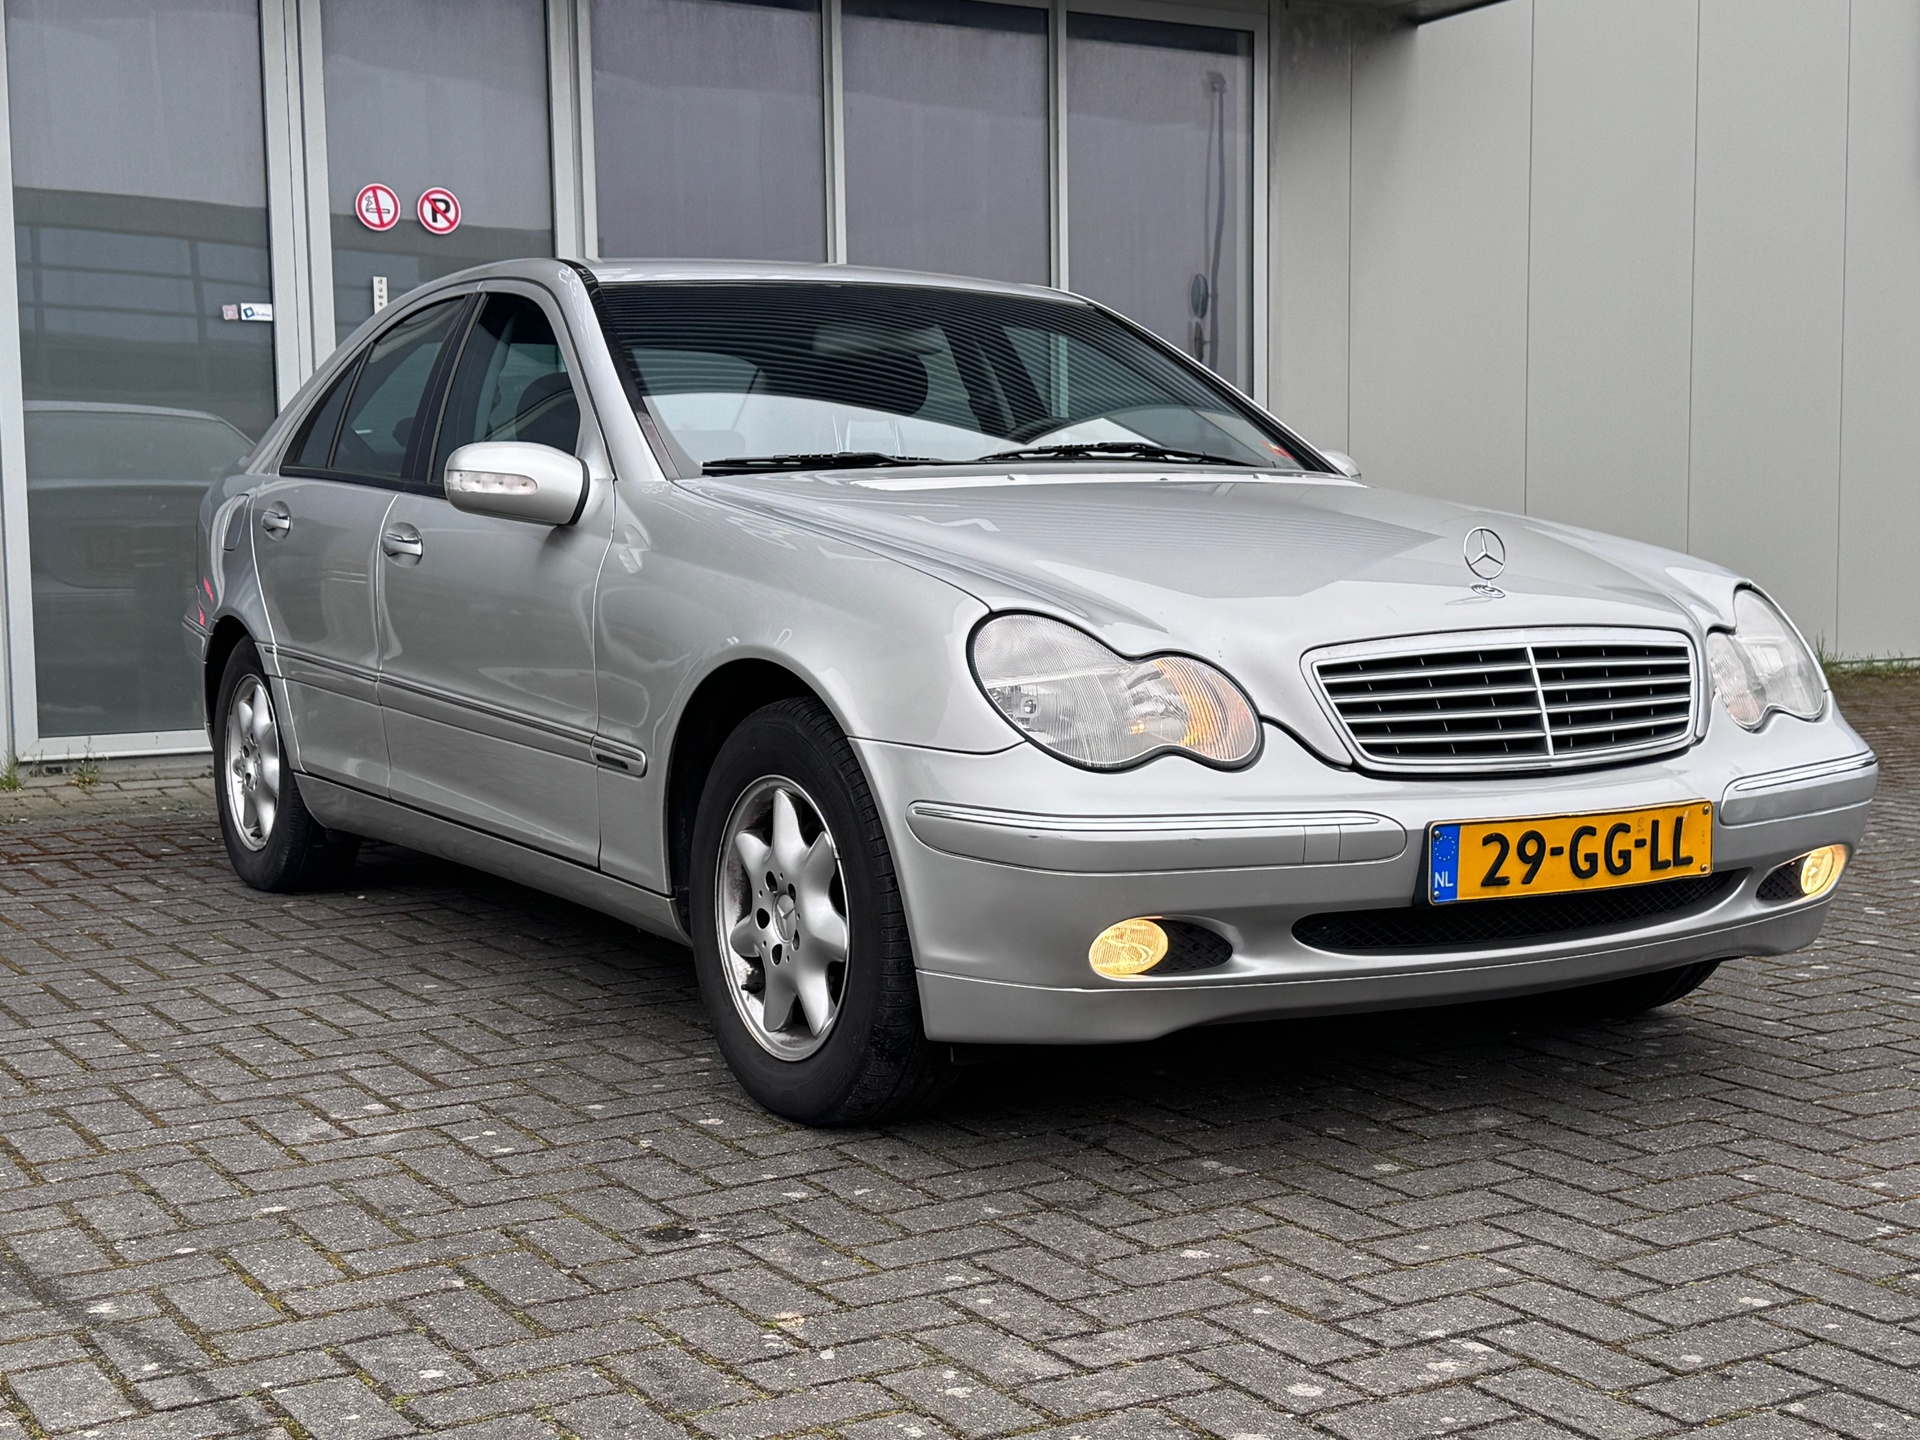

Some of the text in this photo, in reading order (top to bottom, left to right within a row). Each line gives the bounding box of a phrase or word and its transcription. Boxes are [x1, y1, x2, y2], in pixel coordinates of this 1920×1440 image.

[431, 198, 450, 223] P
[1481, 816, 1693, 887] 29-GG-LL
[1434, 871, 1454, 888] NL
